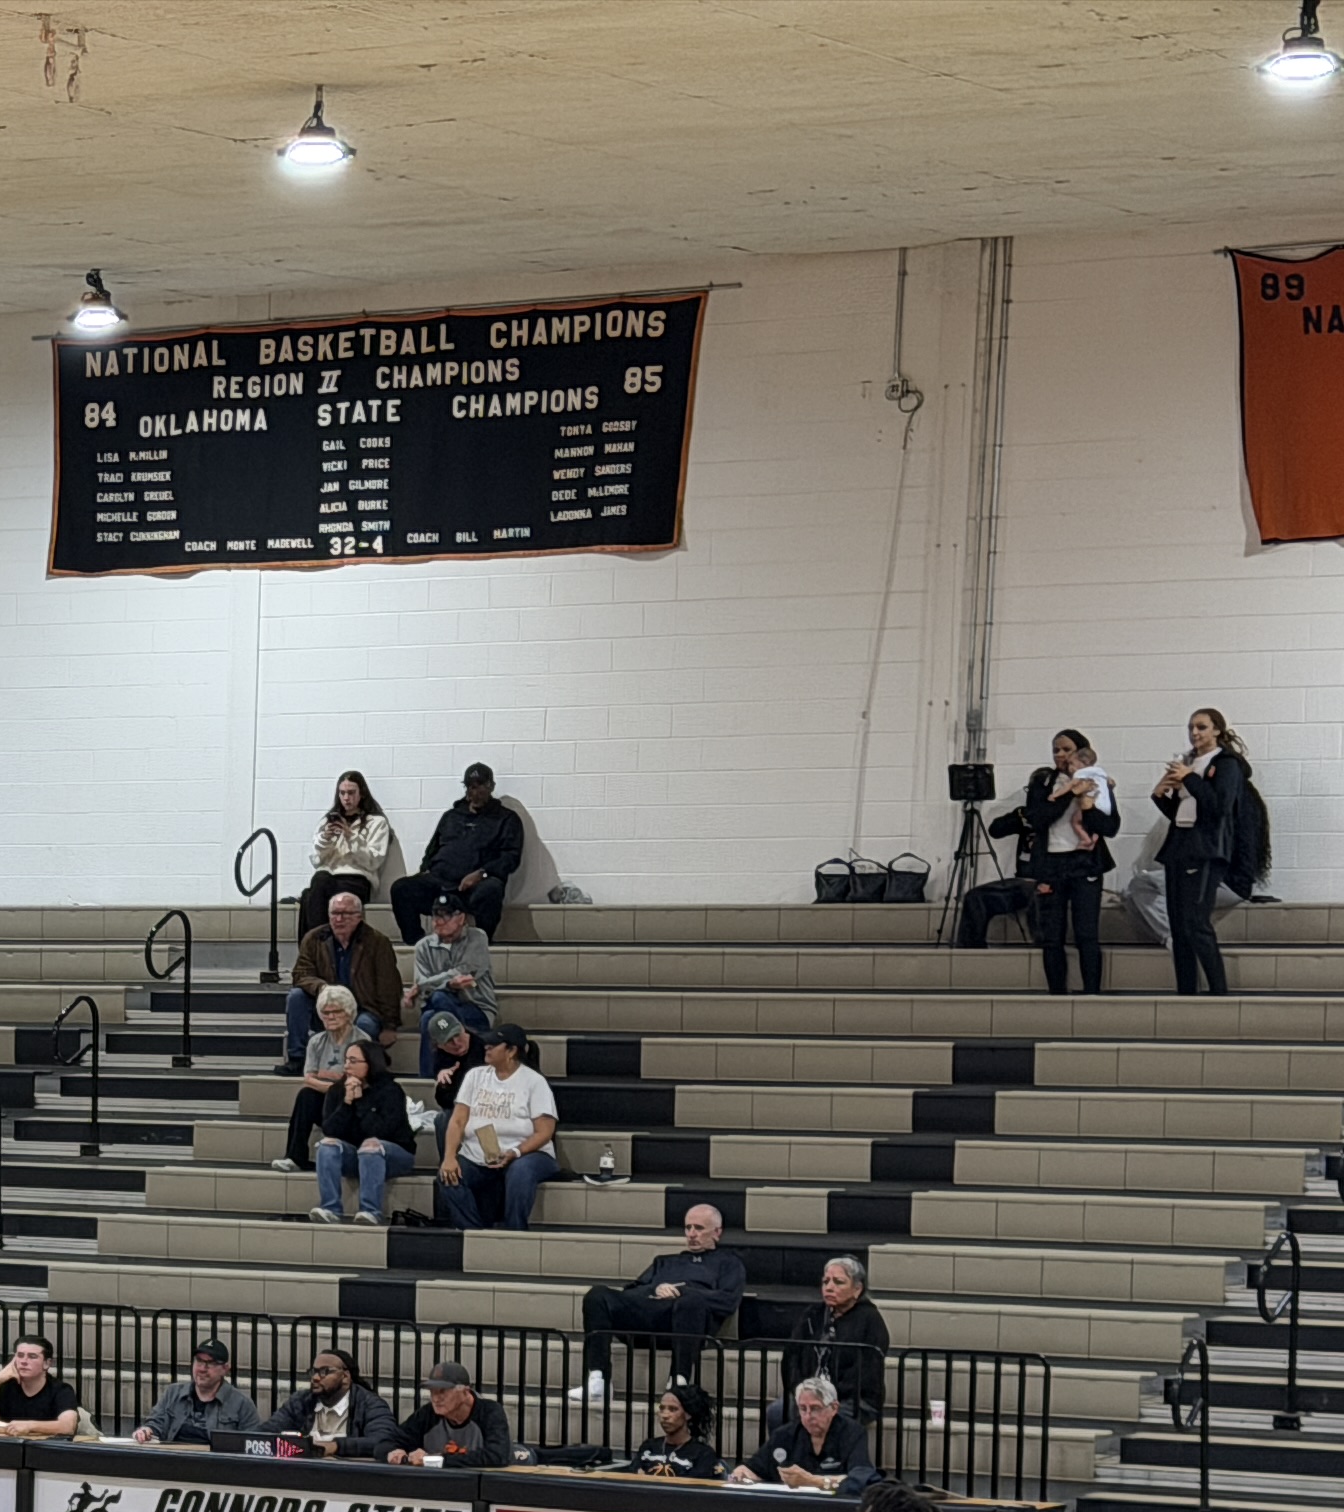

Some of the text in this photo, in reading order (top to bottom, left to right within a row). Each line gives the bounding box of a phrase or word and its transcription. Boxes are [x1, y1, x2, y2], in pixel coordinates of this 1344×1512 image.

[1260, 273, 1304, 302] 89
[85, 310, 666, 377] NATIONAL BASKETBALL CHAMPIONS
[213, 358, 520, 399] REGION II CHAMPIONS
[624, 365, 663, 394] 85
[84, 402, 116, 428] 84
[139, 386, 599, 438] OKLAHOMA STATE CHAMPIONS
[185, 541, 216, 552] COACH
[407, 532, 440, 544] COACH
[245, 1440, 274, 1456] POSS.
